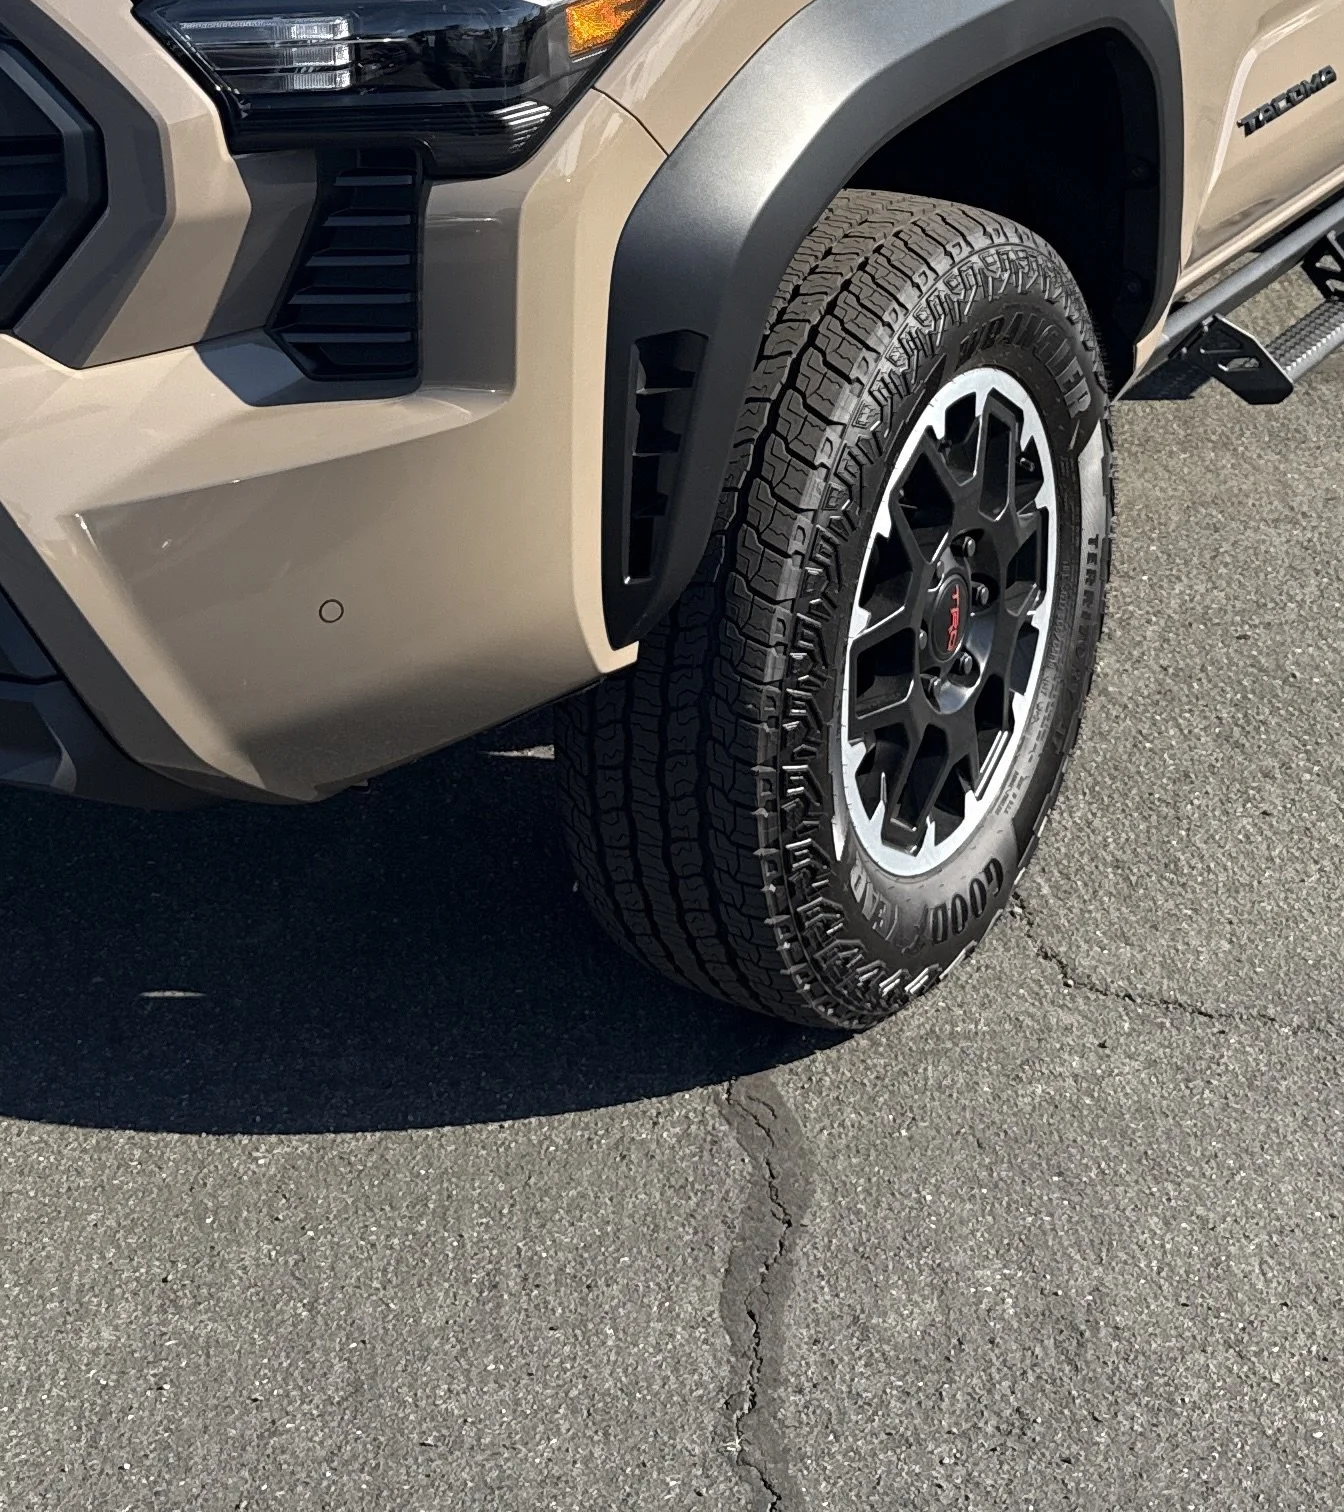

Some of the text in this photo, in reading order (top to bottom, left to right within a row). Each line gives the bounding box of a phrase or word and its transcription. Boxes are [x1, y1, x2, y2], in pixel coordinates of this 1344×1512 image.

[1236, 64, 1338, 138] TACOMA
[955, 311, 1092, 410] WRANGLER
[946, 583, 960, 653] TRD
[849, 857, 1005, 956] GOODYEAR
